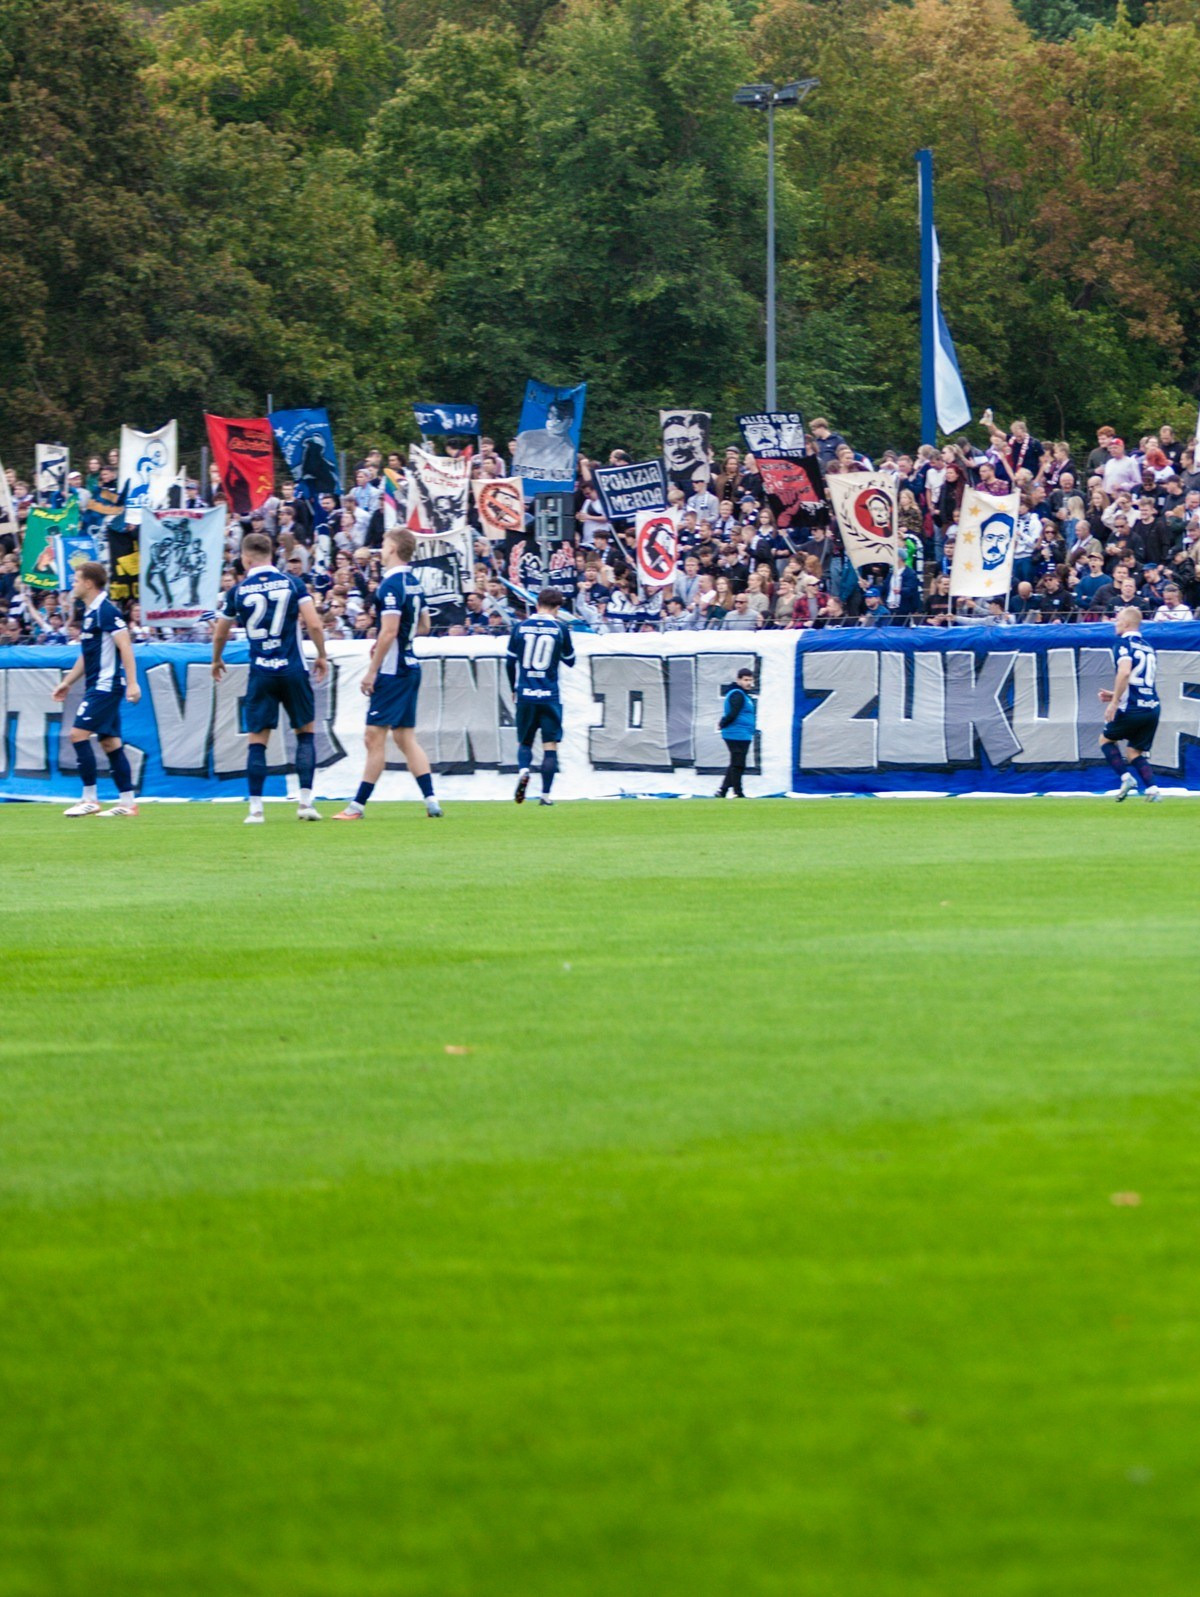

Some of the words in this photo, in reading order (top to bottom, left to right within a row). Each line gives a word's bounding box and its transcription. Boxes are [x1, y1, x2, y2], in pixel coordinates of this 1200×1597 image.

[610, 487, 665, 512] MERDA
[239, 580, 290, 595] BABELSBERG
[242, 588, 292, 640] 27
[255, 656, 289, 670] Katjes
[522, 633, 556, 671] 10
[589, 653, 760, 773] DIE
